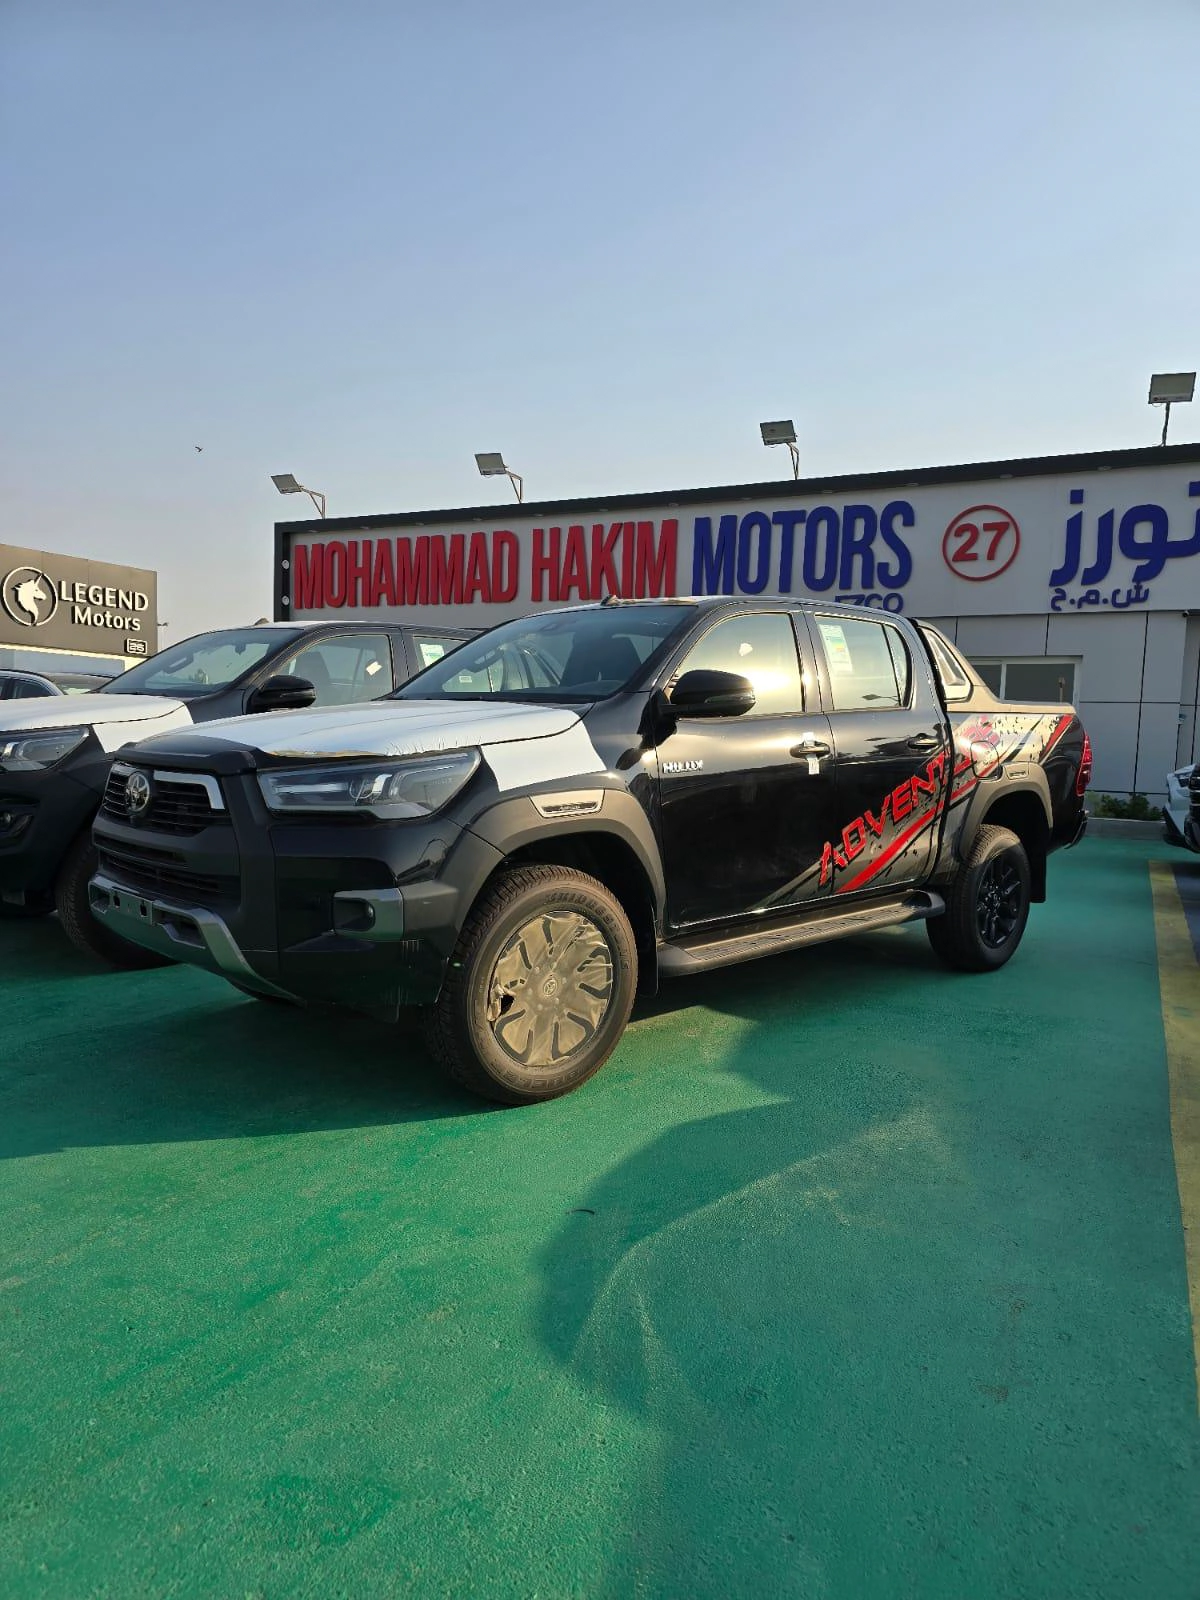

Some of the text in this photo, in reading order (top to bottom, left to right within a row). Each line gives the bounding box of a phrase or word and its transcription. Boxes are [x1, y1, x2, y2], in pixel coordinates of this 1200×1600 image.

[294, 500, 916, 609] MOHAMMAD HAKIM MOTORS
[951, 521, 1010, 562] 27
[59, 580, 149, 611] LEGEND
[73, 605, 141, 631] Motors
